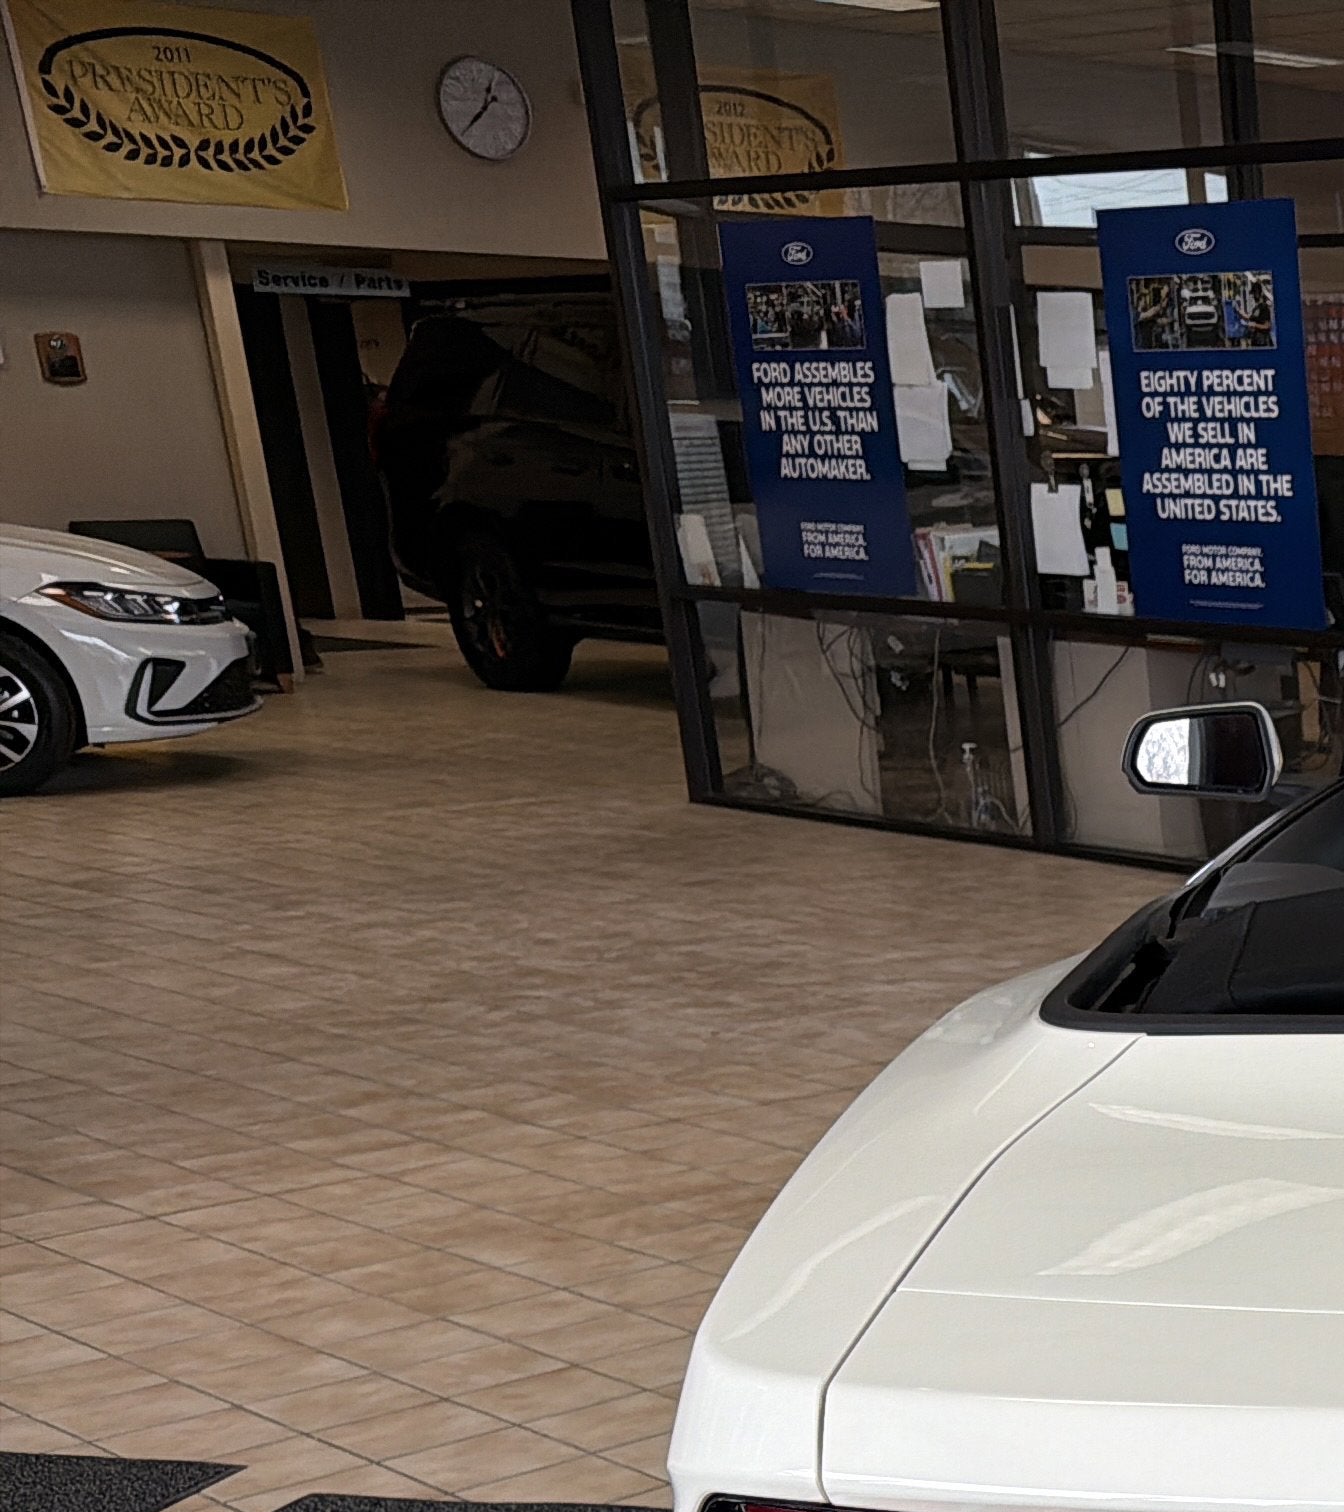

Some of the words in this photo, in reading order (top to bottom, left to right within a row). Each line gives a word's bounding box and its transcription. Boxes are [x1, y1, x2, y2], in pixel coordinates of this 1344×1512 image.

[153, 45, 191, 63] 2011
[66, 57, 292, 107] PRESIDENT'S
[126, 96, 245, 131] AWARD
[704, 121, 817, 153] SIDENT'S
[708, 148, 783, 173] WARD
[257, 269, 330, 288] Service
[353, 273, 404, 291] Parts
[752, 362, 790, 384] FORD
[794, 361, 874, 384] ASSEMBLES
[1139, 370, 1198, 392] EIGHTY
[1202, 369, 1275, 392] PERCENT
[761, 386, 803, 407] MORE
[804, 386, 871, 408] VEHICLES
[1141, 396, 1163, 418] OF
[1166, 396, 1199, 418] THE
[1202, 395, 1279, 418] VEHICLES
[760, 410, 776, 431] IN
[777, 410, 807, 431] THE
[808, 410, 836, 431] U.S.
[836, 410, 879, 432] THAN
[1167, 421, 1194, 443] WE
[1197, 422, 1235, 444] SELL
[1237, 422, 1256, 444] IN
[782, 433, 810, 455] ANY
[813, 434, 862, 456] OTHER
[780, 457, 871, 480] AUTOMAKER.
[1161, 447, 1232, 469] AMERICA
[1235, 448, 1268, 470] ARE
[1142, 472, 1234, 495] ASSEMBLED
[1237, 473, 1256, 496] IN
[1258, 474, 1293, 496] THE
[1156, 497, 1216, 520] UNITED
[1219, 499, 1282, 522] STATES.
[1183, 555, 1213, 569] FROM
[1216, 556, 1264, 571] AMERICA.
[1184, 569, 1208, 585] FOR
[1211, 570, 1266, 588] AMERICA.
